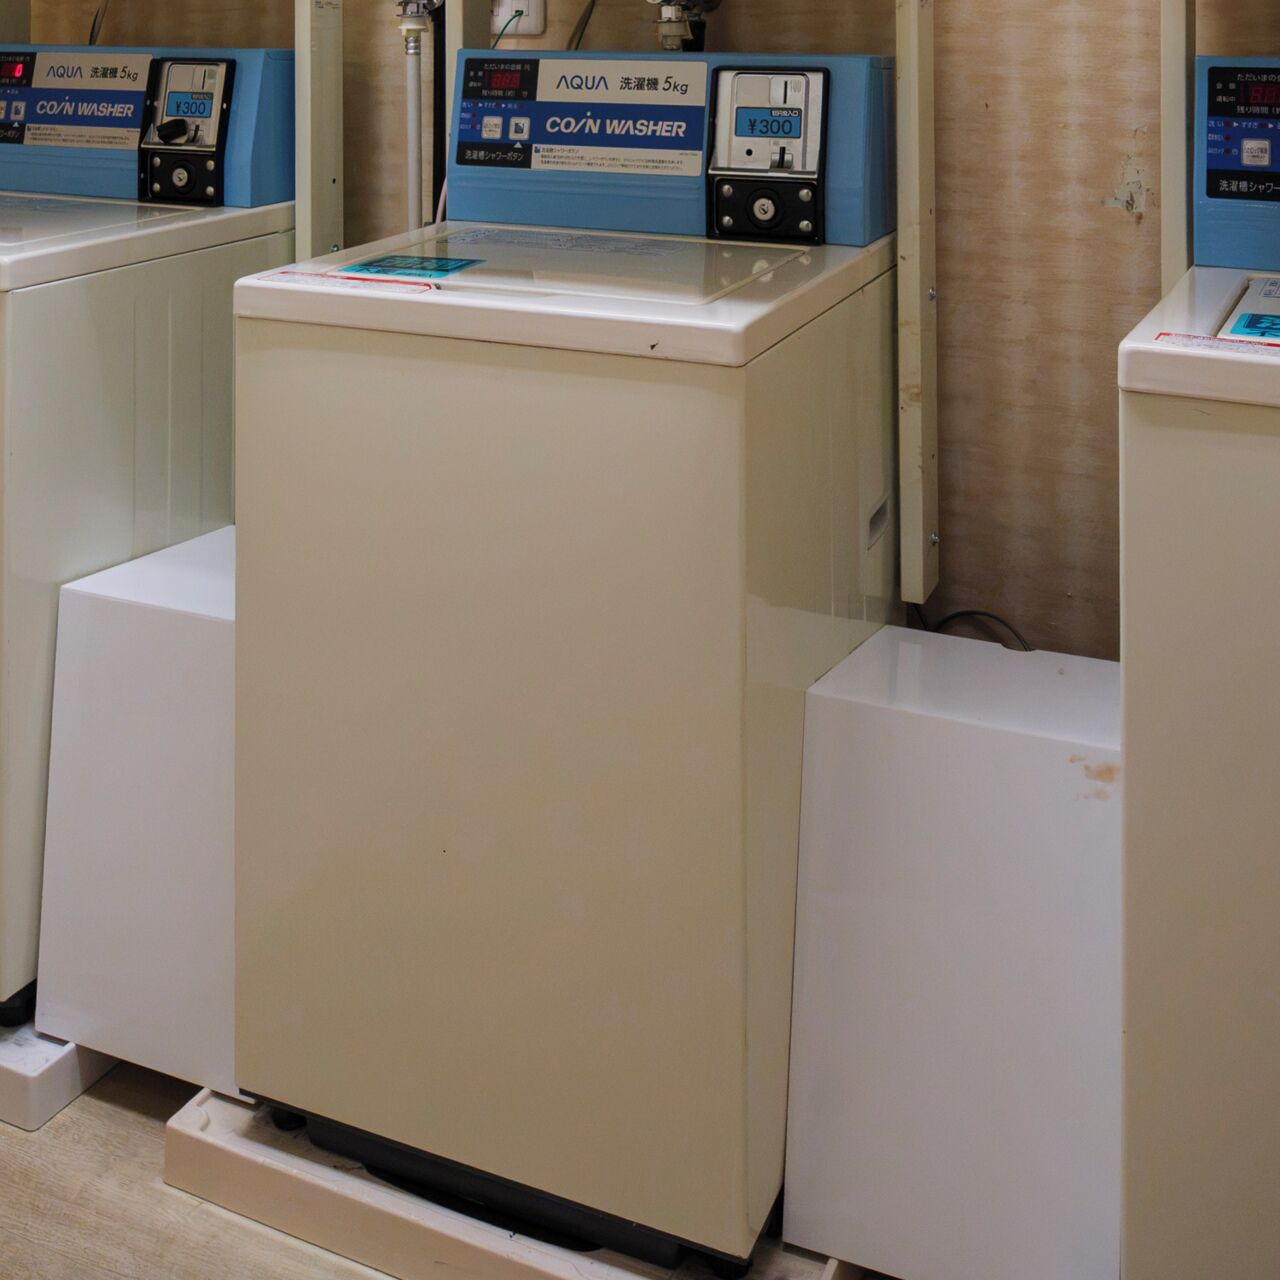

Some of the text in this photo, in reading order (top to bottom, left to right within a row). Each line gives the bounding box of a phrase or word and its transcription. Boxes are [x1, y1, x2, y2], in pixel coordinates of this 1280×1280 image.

[46, 65, 83, 79] AQUA
[119, 65, 139, 82] 5kg
[556, 74, 689, 95] AQUA 洗濯機 5kg
[77, 102, 135, 118] WASHER
[175, 101, 206, 115] ¥300
[605, 118, 687, 137] WASHER
[748, 118, 793, 136] ¥300
